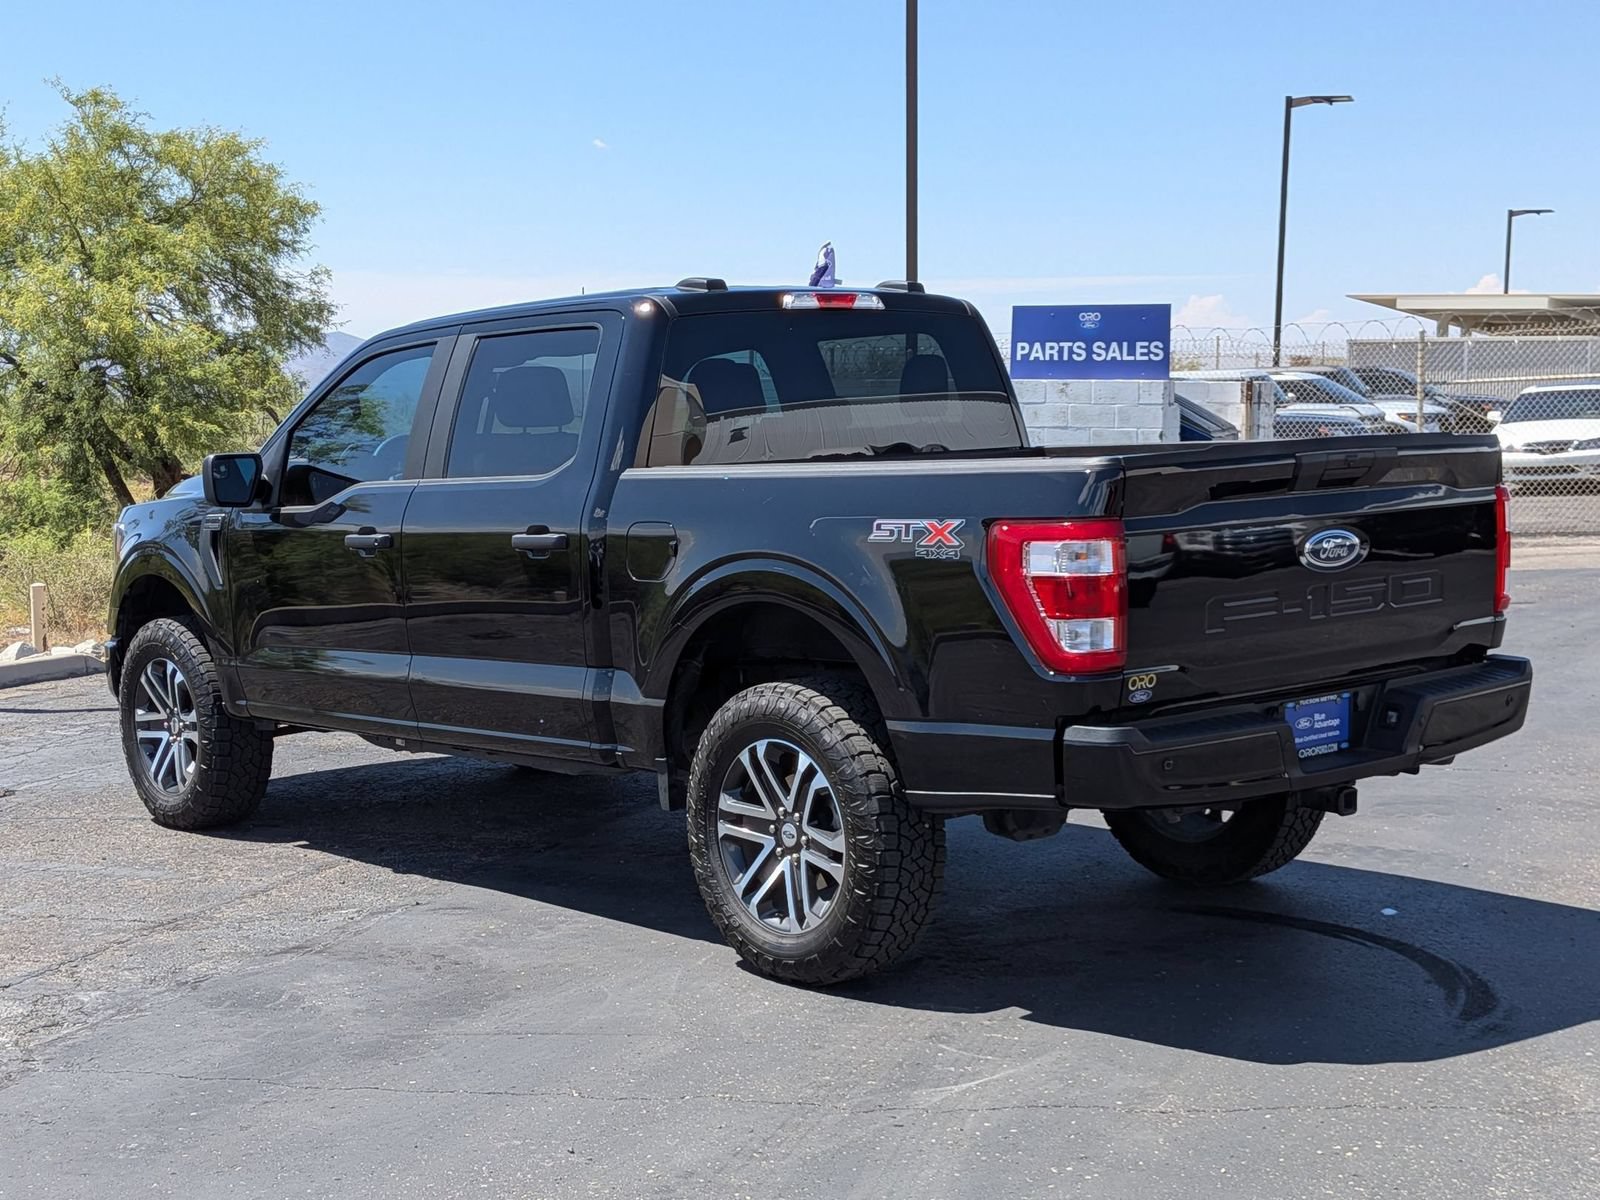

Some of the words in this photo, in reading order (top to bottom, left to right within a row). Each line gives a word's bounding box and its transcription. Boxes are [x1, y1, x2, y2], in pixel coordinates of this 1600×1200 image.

[1079, 311, 1101, 321] ORO
[1016, 341, 1086, 361] PARTS
[1092, 341, 1164, 361] SALES
[868, 518, 966, 550] STX
[1319, 536, 1352, 560] Ford
[1205, 569, 1443, 634] F-150
[1128, 673, 1157, 691] ORO
[1299, 697, 1320, 706] TUCSON
[1320, 694, 1338, 702] METRO
[1313, 713, 1326, 721] Blue
[1313, 718, 1341, 729] Advantage
